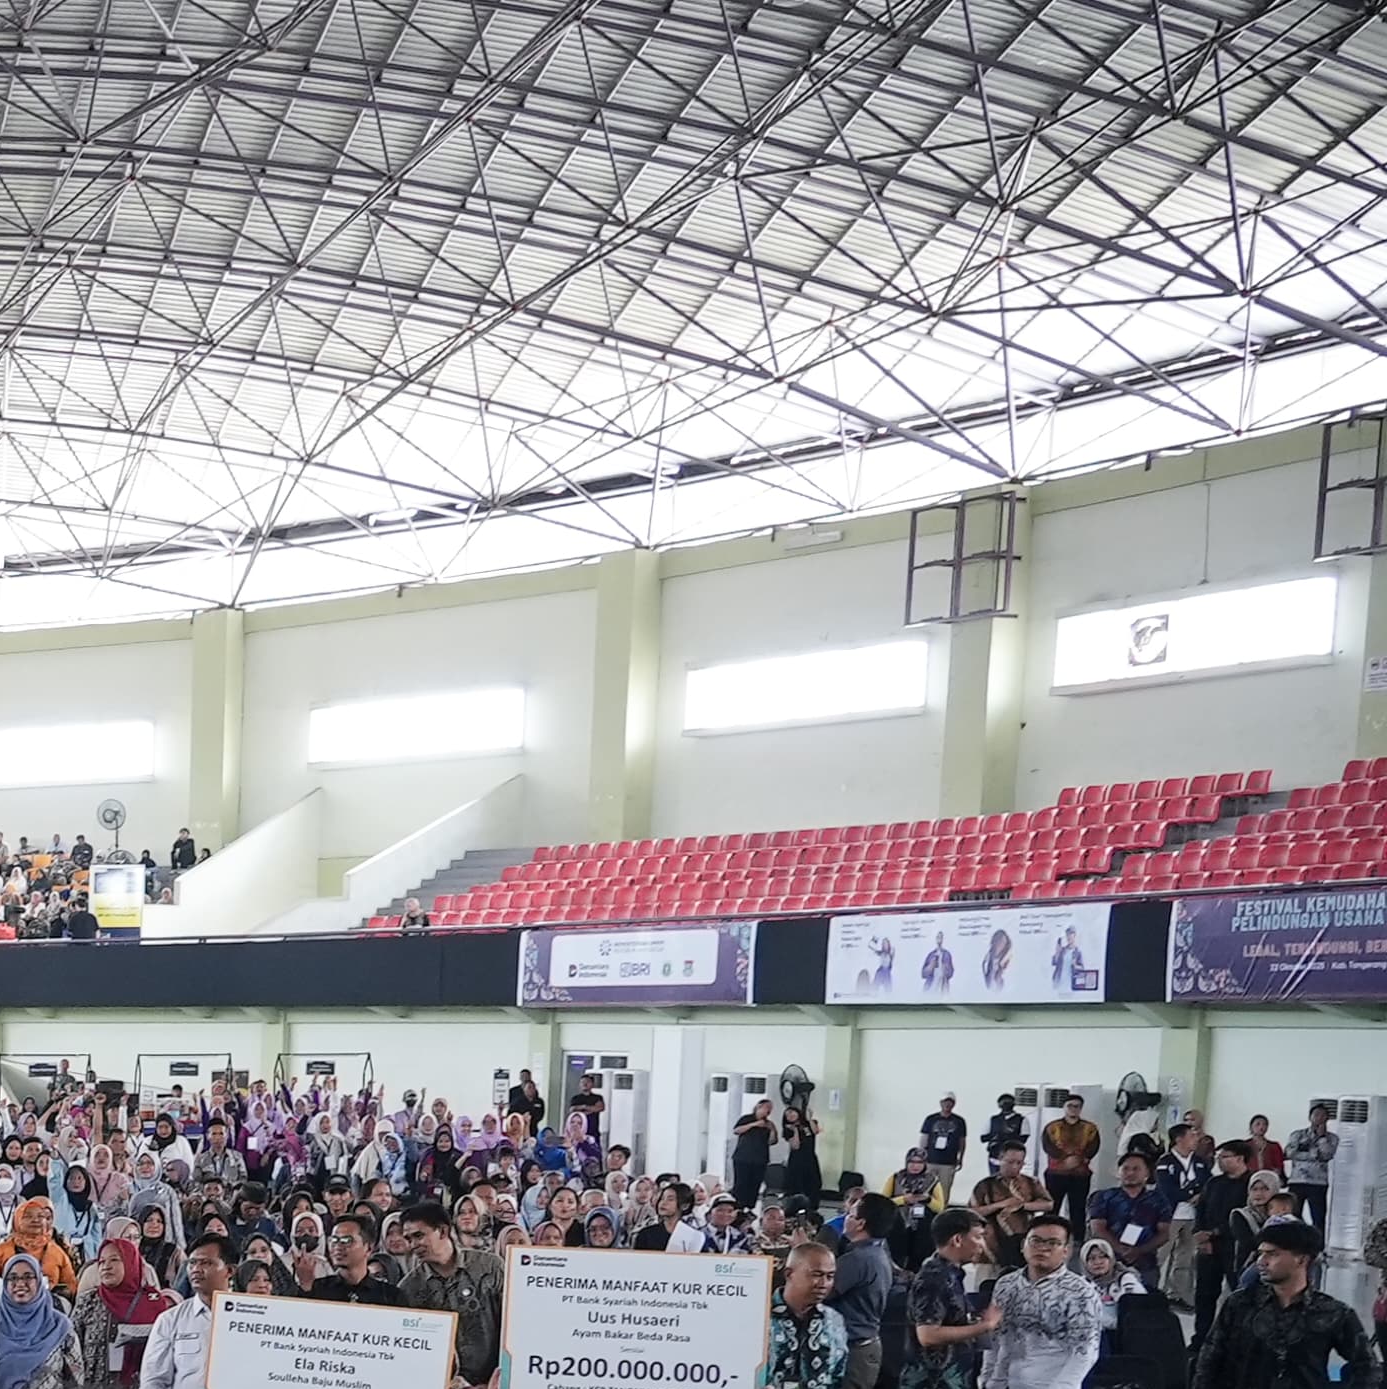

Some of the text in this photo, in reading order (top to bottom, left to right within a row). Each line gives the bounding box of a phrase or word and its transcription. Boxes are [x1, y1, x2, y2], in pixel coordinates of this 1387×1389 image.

[1236, 901, 1303, 917] FESTIVAL
[1231, 908, 1385, 932] PELINDUNGAN USAHA
[526, 1275, 748, 1297] PENERIMA MANFAAT KUR KECIL
[562, 1295, 708, 1310] PT Bank Syariah Indonesia Tbk
[587, 1311, 680, 1327] Uus Husaeri
[228, 1320, 433, 1351] PENERIMA MANFAAT KUR KECIL
[572, 1329, 691, 1343] Ayam Bakar Beda Rasa
[260, 1340, 395, 1361] PT Bank Syariah Indonesia Tbk
[294, 1357, 356, 1375] Ela Riska
[527, 1355, 739, 1389] Rp200.000.000,-
[268, 1372, 310, 1384] Soulleha
[311, 1375, 333, 1388] Baju
